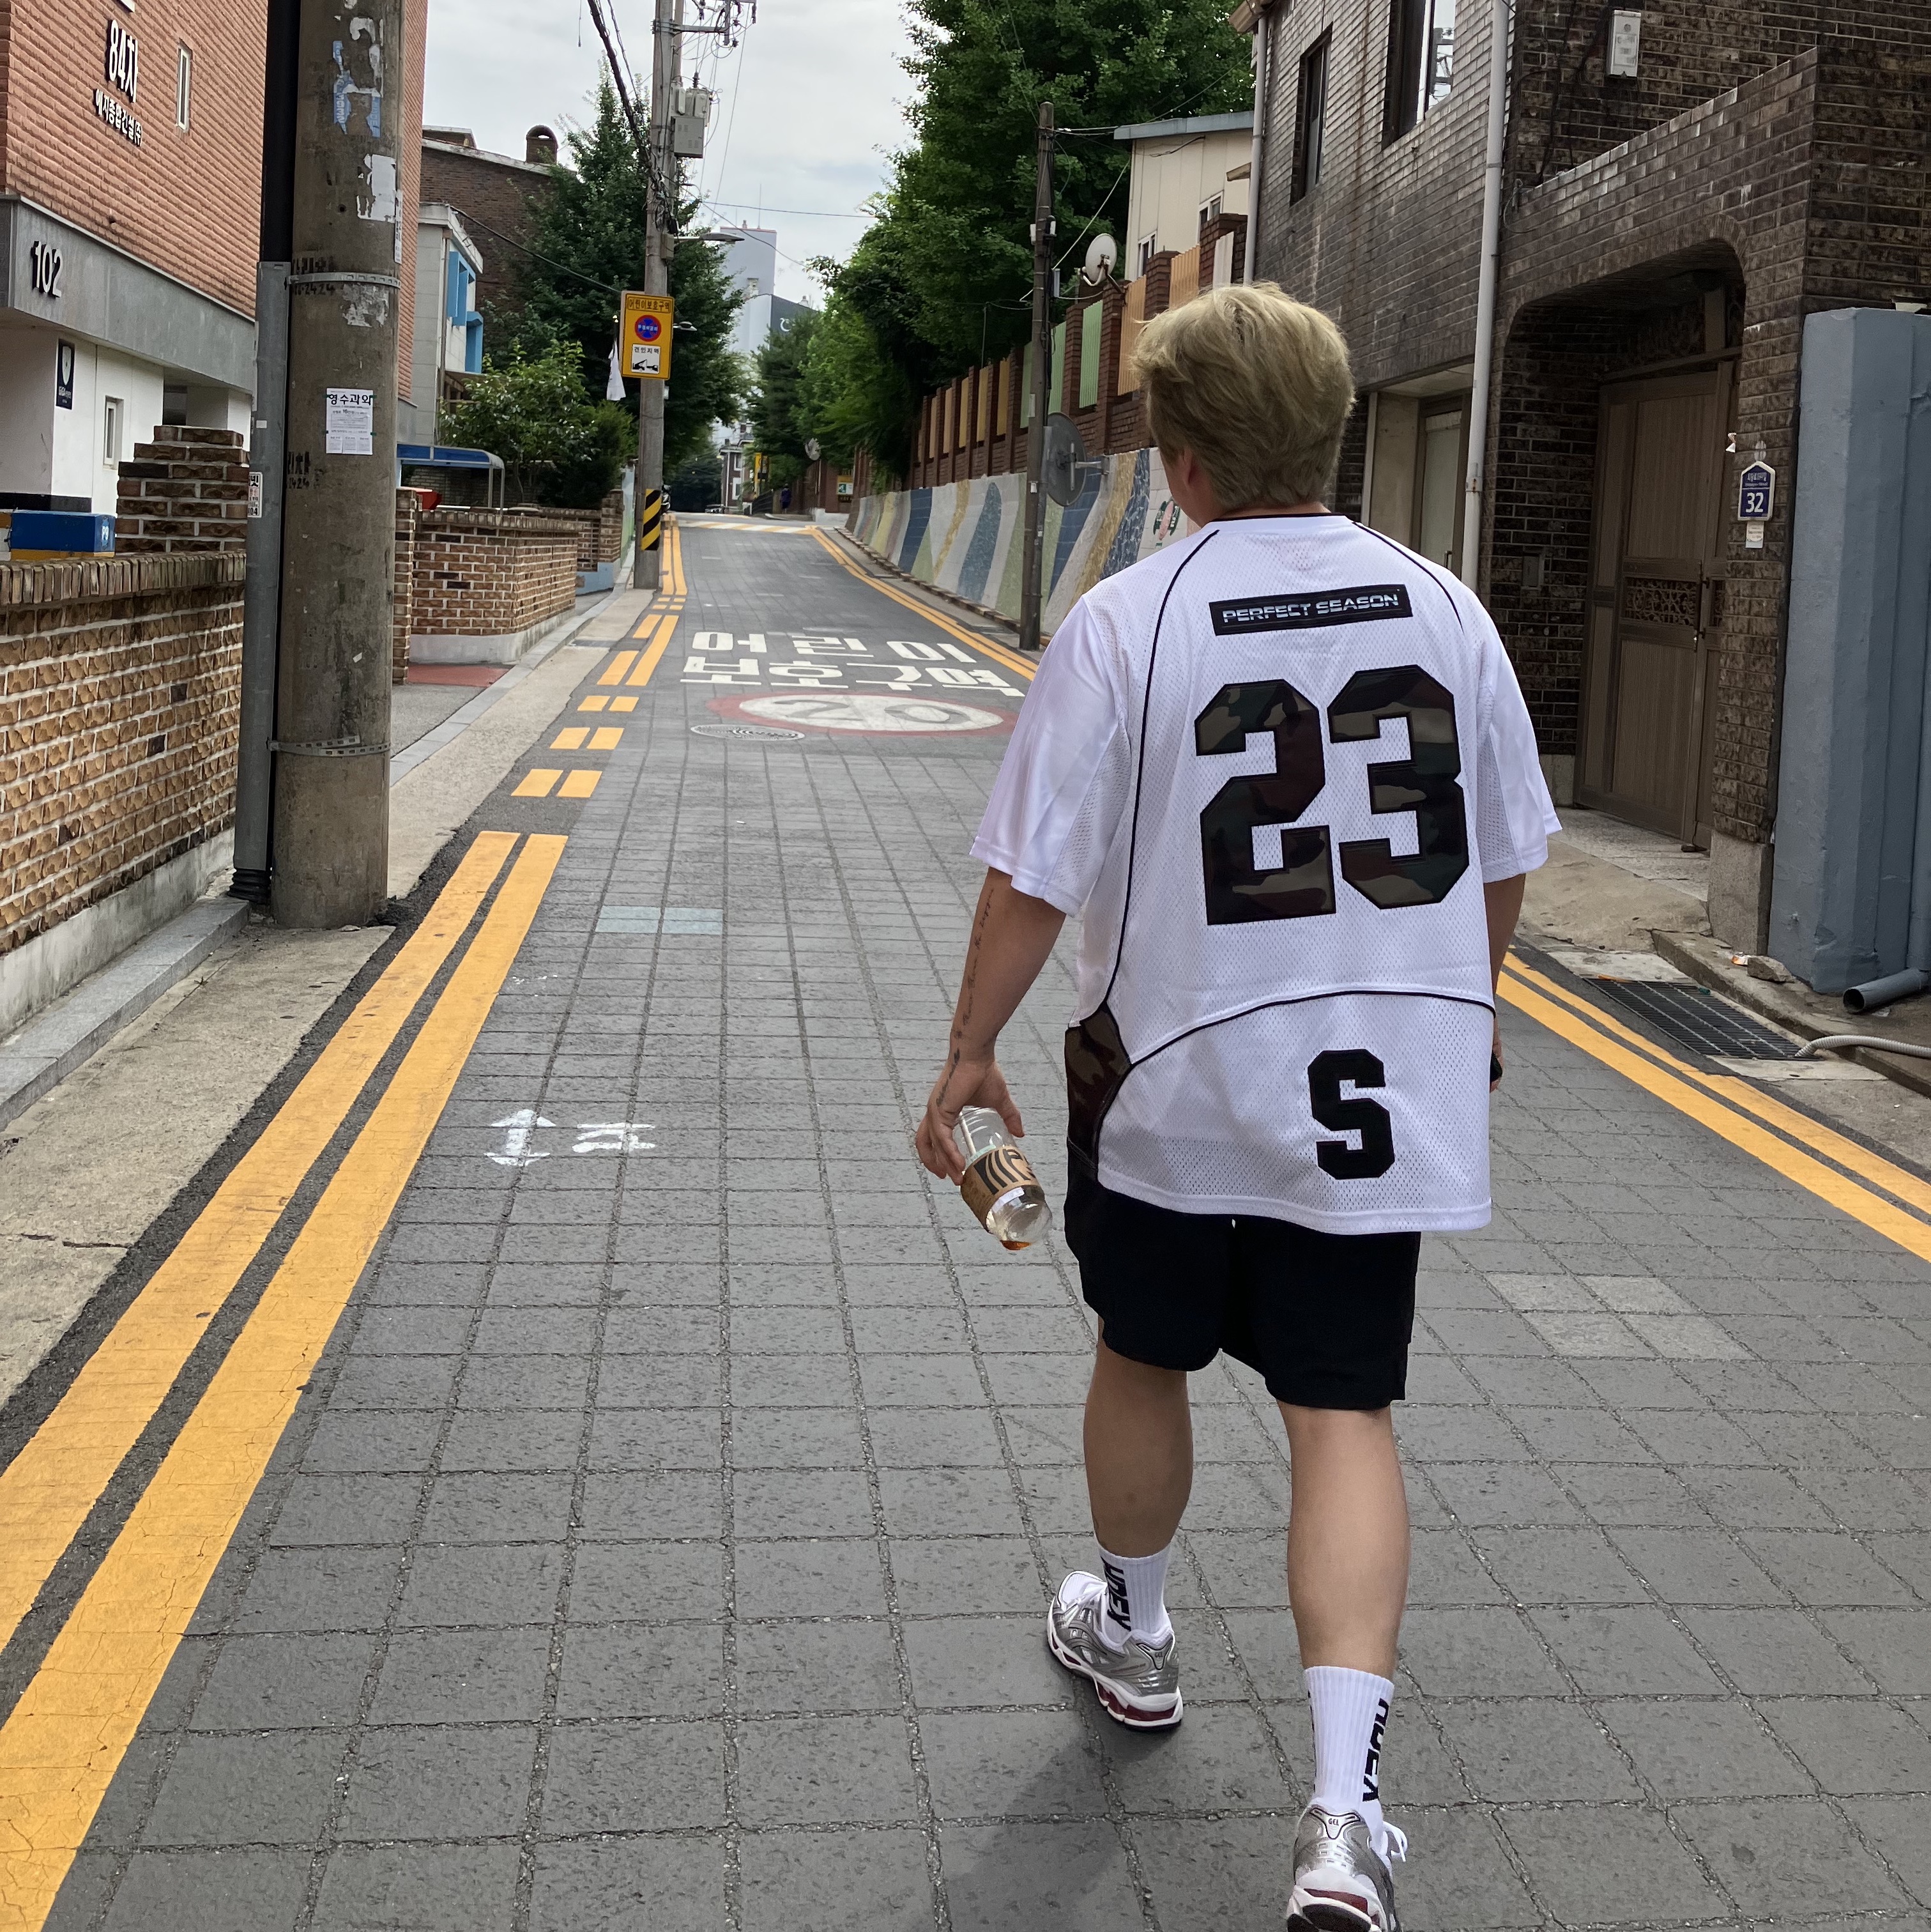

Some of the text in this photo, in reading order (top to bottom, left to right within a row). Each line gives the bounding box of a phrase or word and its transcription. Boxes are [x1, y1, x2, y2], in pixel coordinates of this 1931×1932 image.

[109, 19, 139, 103] 84차
[34, 240, 63, 298] 102
[629, 298, 670, 312] 어린이보호구역
[634, 346, 659, 355] 견인지역
[328, 394, 371, 406] 영수과외
[1745, 492, 1764, 513] 32
[1223, 594, 1399, 623] PERFECT SEASON
[692, 631, 977, 663] 어린이
[680, 656, 1025, 697] 보호구역
[1194, 664, 1470, 926] 23
[1308, 1048, 1395, 1180] S
